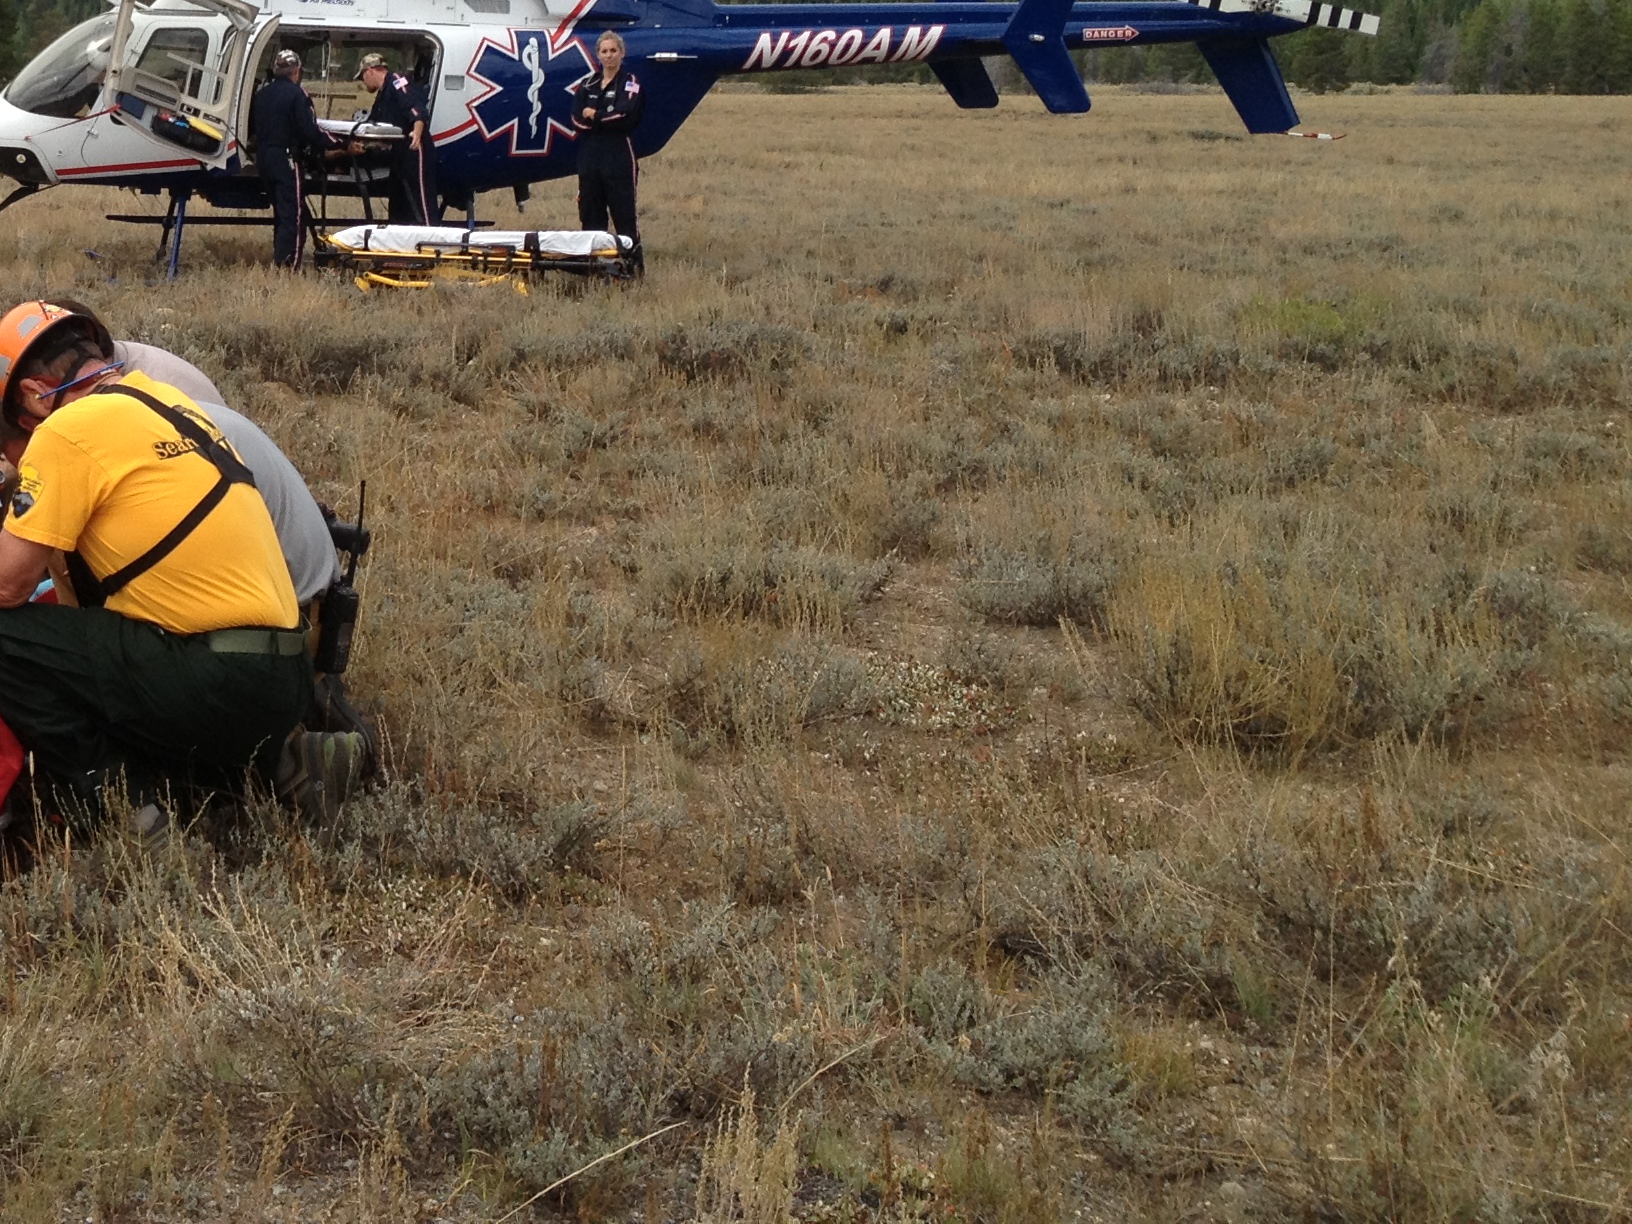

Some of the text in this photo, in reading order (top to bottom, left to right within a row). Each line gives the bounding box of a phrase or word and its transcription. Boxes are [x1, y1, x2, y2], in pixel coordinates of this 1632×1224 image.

[1085, 29, 1133, 39] DANGER
[742, 24, 946, 70] N160AM
[152, 438, 200, 461] Sear
